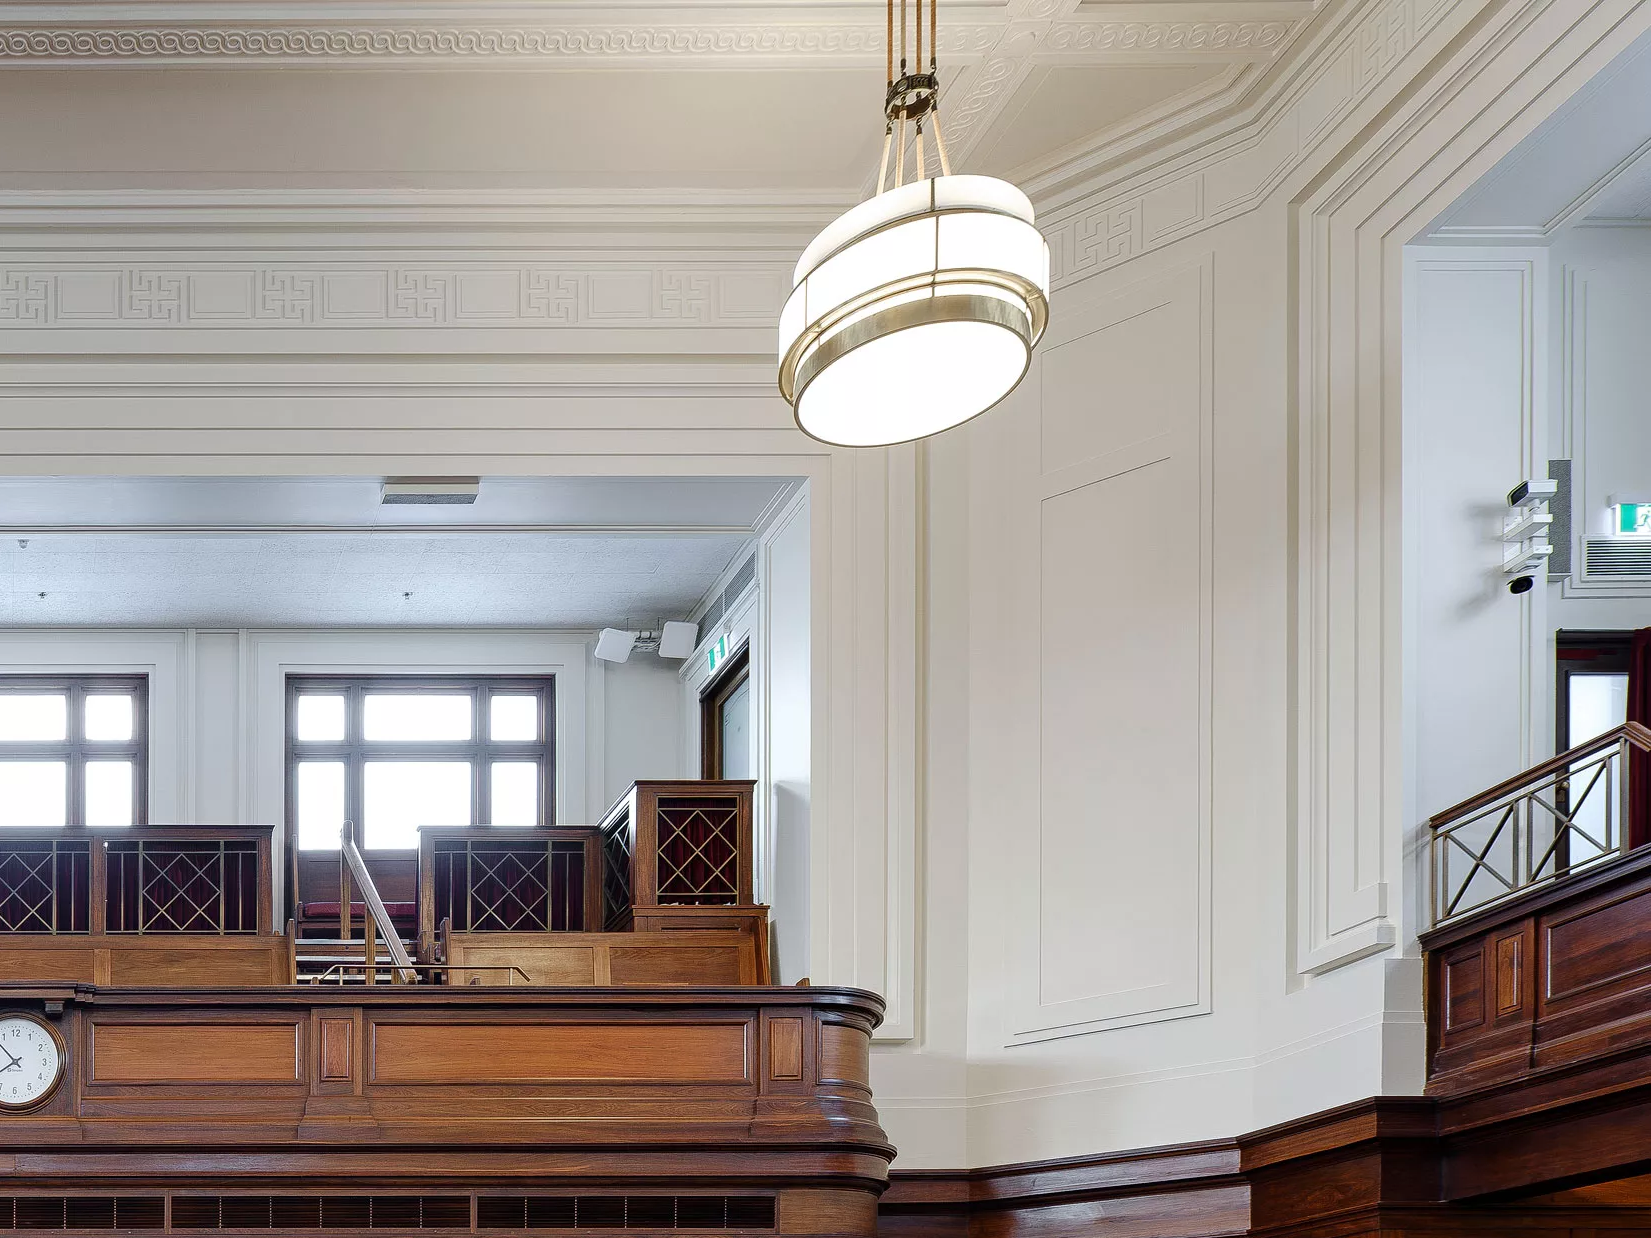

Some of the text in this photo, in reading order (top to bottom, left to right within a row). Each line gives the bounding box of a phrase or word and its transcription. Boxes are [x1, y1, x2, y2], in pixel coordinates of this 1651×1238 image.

[11, 1029, 21, 1037] 12
[28, 1033, 32, 1041] 1
[38, 1043, 43, 1052] 2
[42, 1058, 47, 1066] 3
[37, 1072, 43, 1080] 4
[12, 1086, 17, 1095] 6
[27, 1083, 32, 1091] 5
